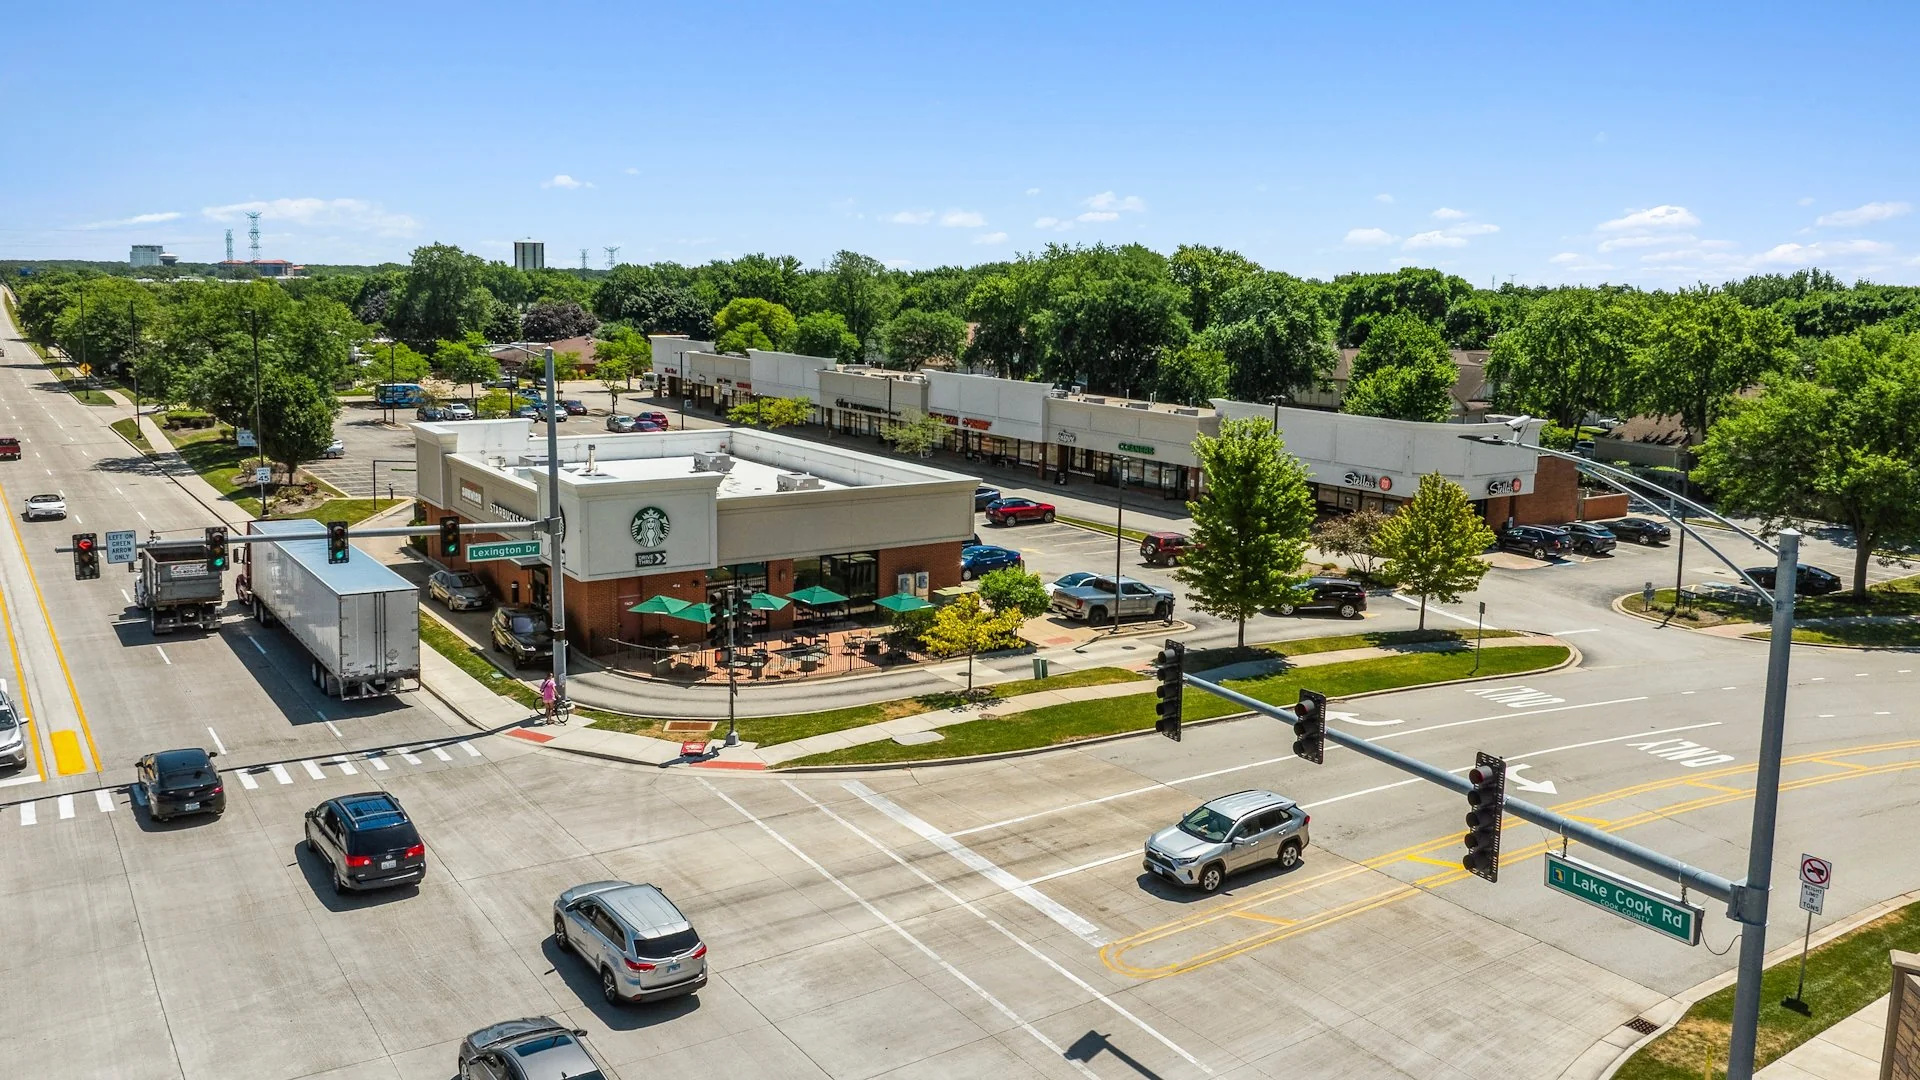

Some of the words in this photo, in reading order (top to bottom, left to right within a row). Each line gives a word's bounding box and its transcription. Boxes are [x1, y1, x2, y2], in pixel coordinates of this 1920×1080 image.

[1118, 442, 1155, 455] CLEANERS
[489, 503, 520, 522] STARBUCKS
[472, 546, 521, 557] Lexington
[525, 545, 537, 553] Dr
[1464, 685, 1566, 708] ONLY
[1625, 738, 1735, 768] ONLY
[1804, 884, 1823, 895] WEIGHT
[1805, 891, 1819, 899] LIMIT
[1572, 872, 1607, 898] Lake
[1615, 890, 1654, 917] Cook
[1662, 907, 1682, 929] Rd
[1803, 901, 1819, 912] TONS
[1600, 899, 1619, 911] COOK
[1621, 907, 1650, 923] COUNTY
